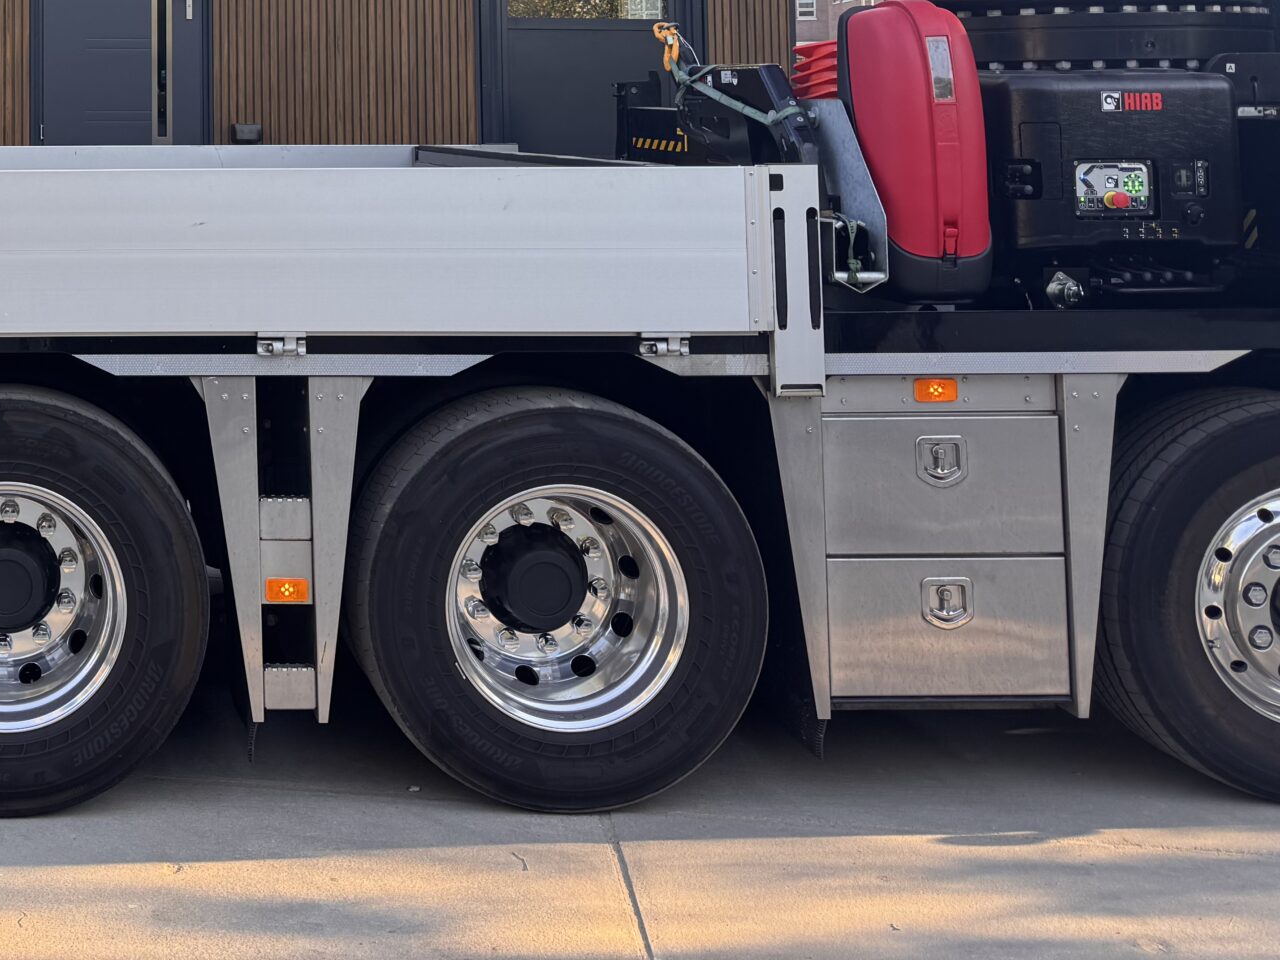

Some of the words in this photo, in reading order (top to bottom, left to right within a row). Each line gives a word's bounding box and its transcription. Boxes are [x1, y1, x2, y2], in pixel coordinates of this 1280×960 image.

[1124, 92, 1162, 111] HIAB
[619, 450, 722, 545] BRIDGESTONE
[72, 661, 164, 768] BRIDGESTONE
